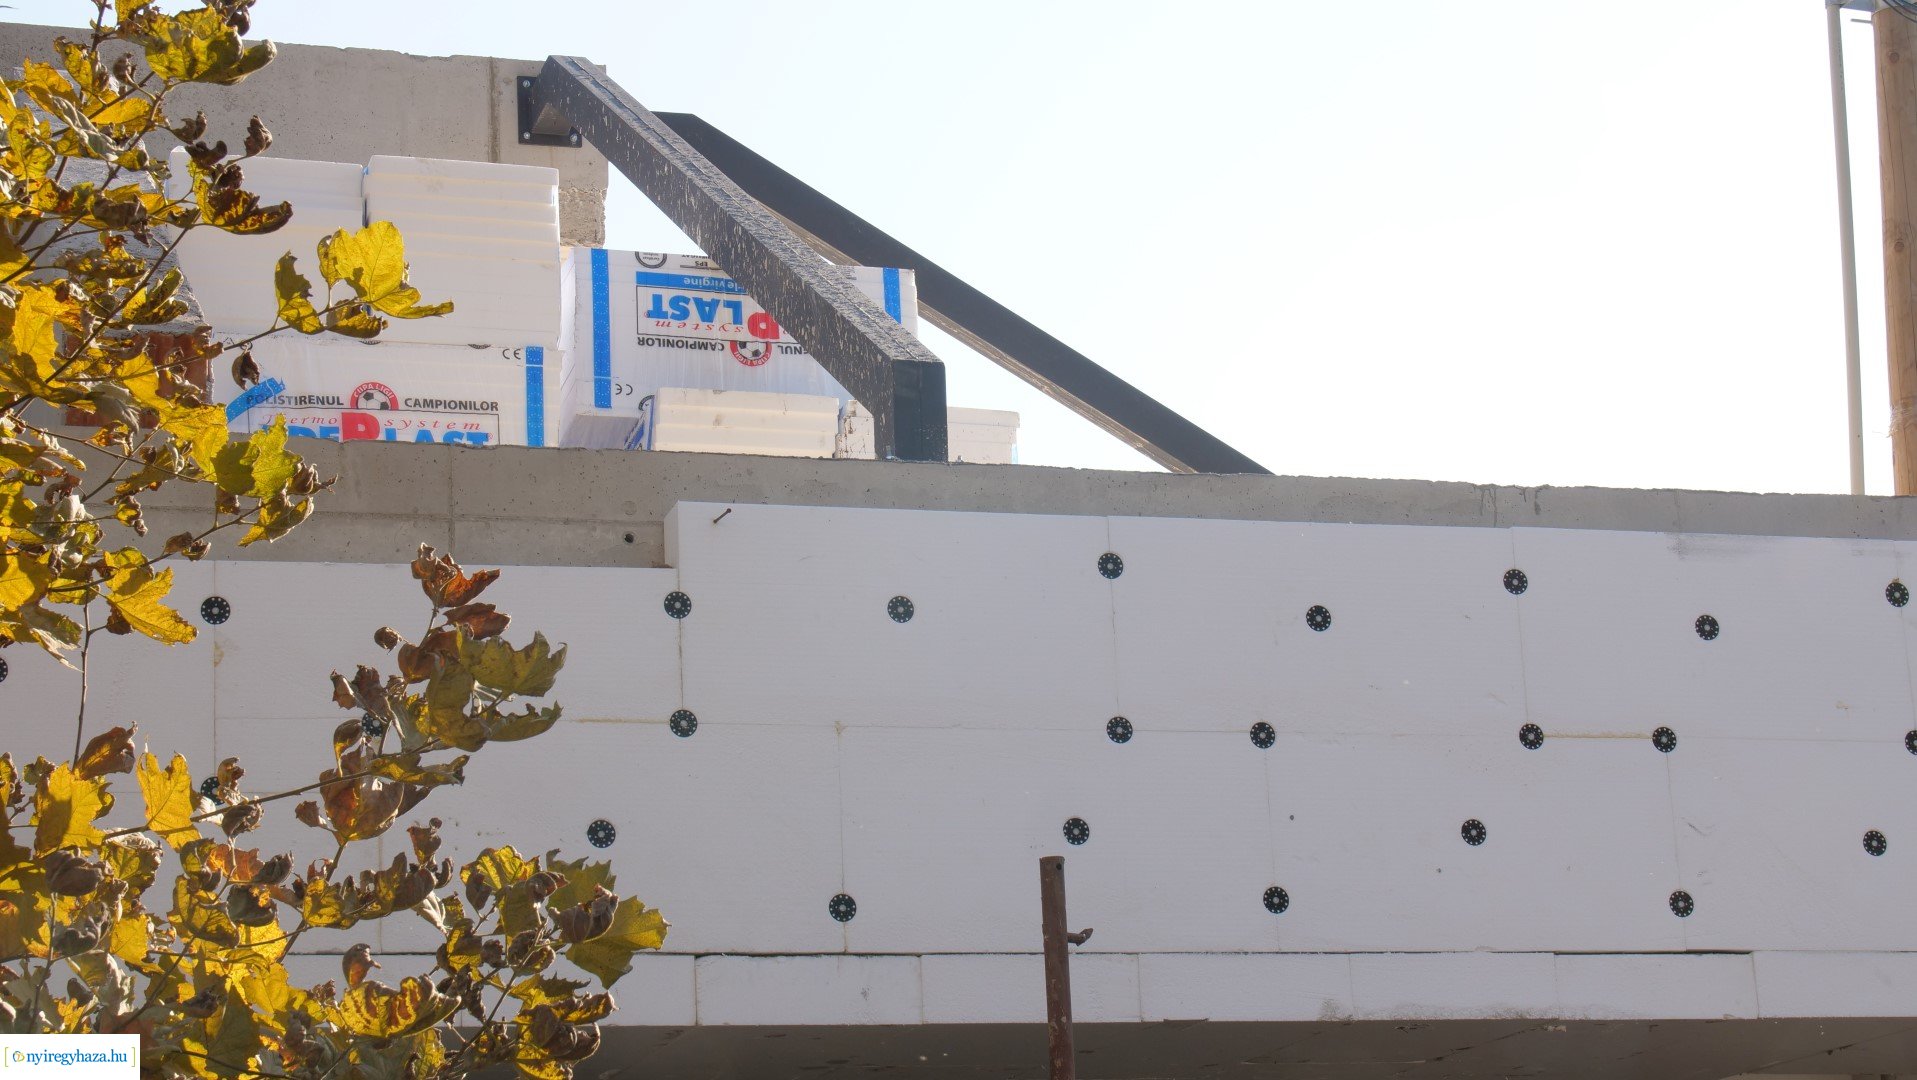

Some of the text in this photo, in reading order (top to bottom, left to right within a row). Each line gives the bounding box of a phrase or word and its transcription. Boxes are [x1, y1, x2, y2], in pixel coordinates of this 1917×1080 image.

[684, 277, 725, 289] virgine
[655, 320, 743, 333] system
[637, 336, 725, 351] CAMPIONILOR
[404, 397, 499, 412] CAMPIONILOR
[262, 413, 481, 430] Termo system
